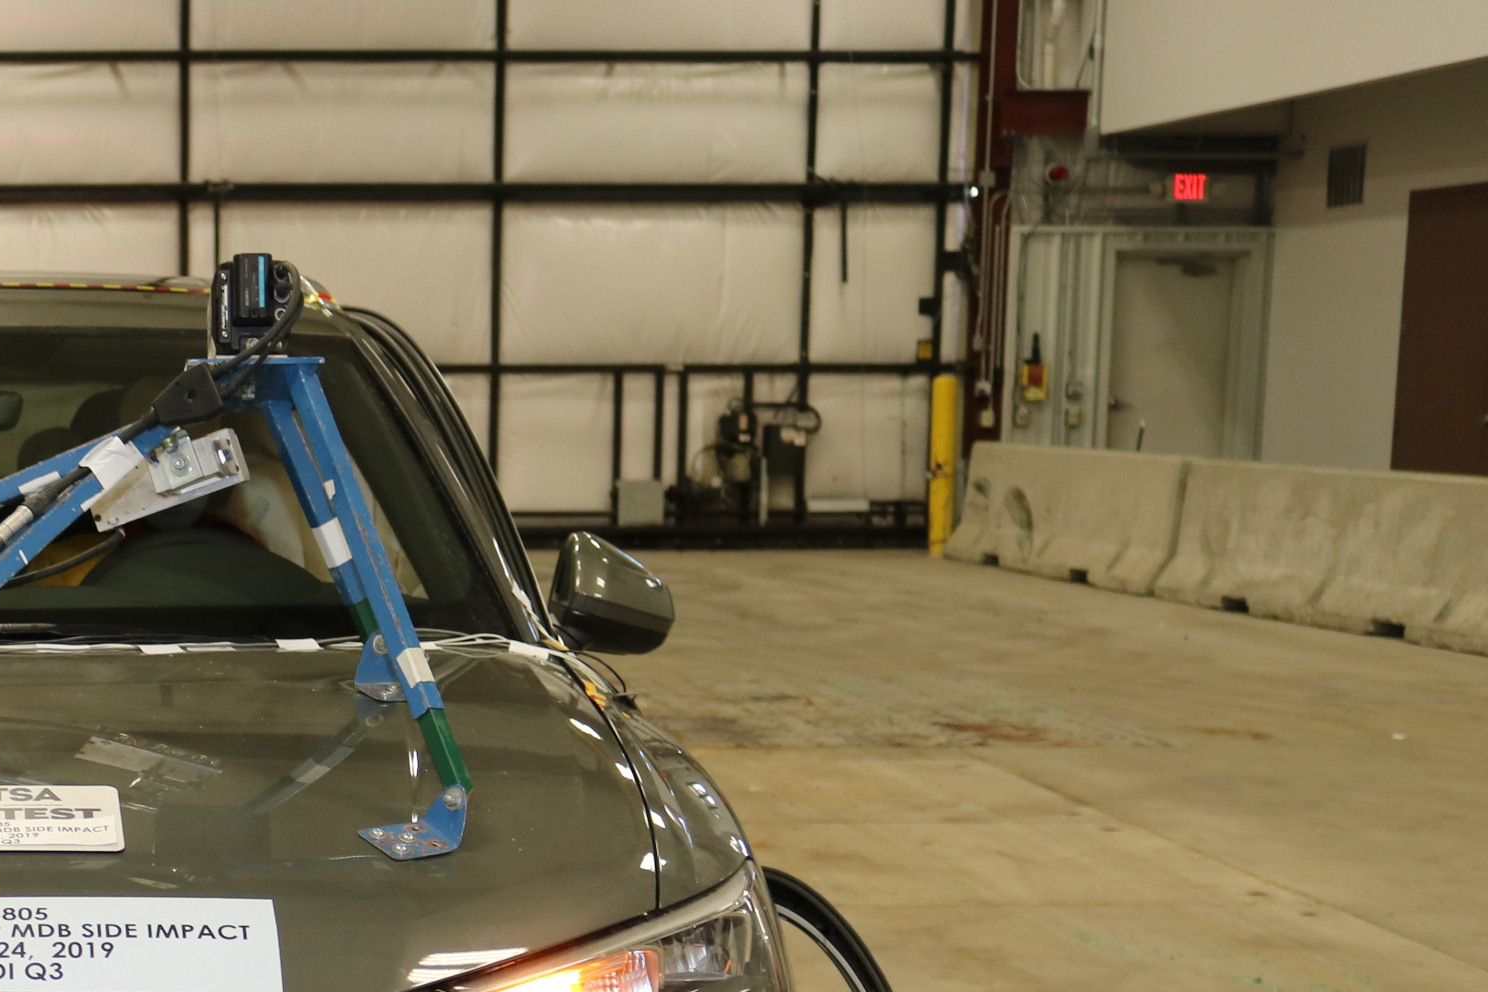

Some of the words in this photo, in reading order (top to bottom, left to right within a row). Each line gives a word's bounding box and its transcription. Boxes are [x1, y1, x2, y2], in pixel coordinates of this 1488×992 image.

[1174, 173, 1207, 200] EXIT
[11, 923, 72, 938] MDB
[82, 923, 138, 938] SIDE
[147, 924, 250, 940] IMPACT
[52, 942, 114, 959] 2019
[25, 962, 64, 981] Q3
